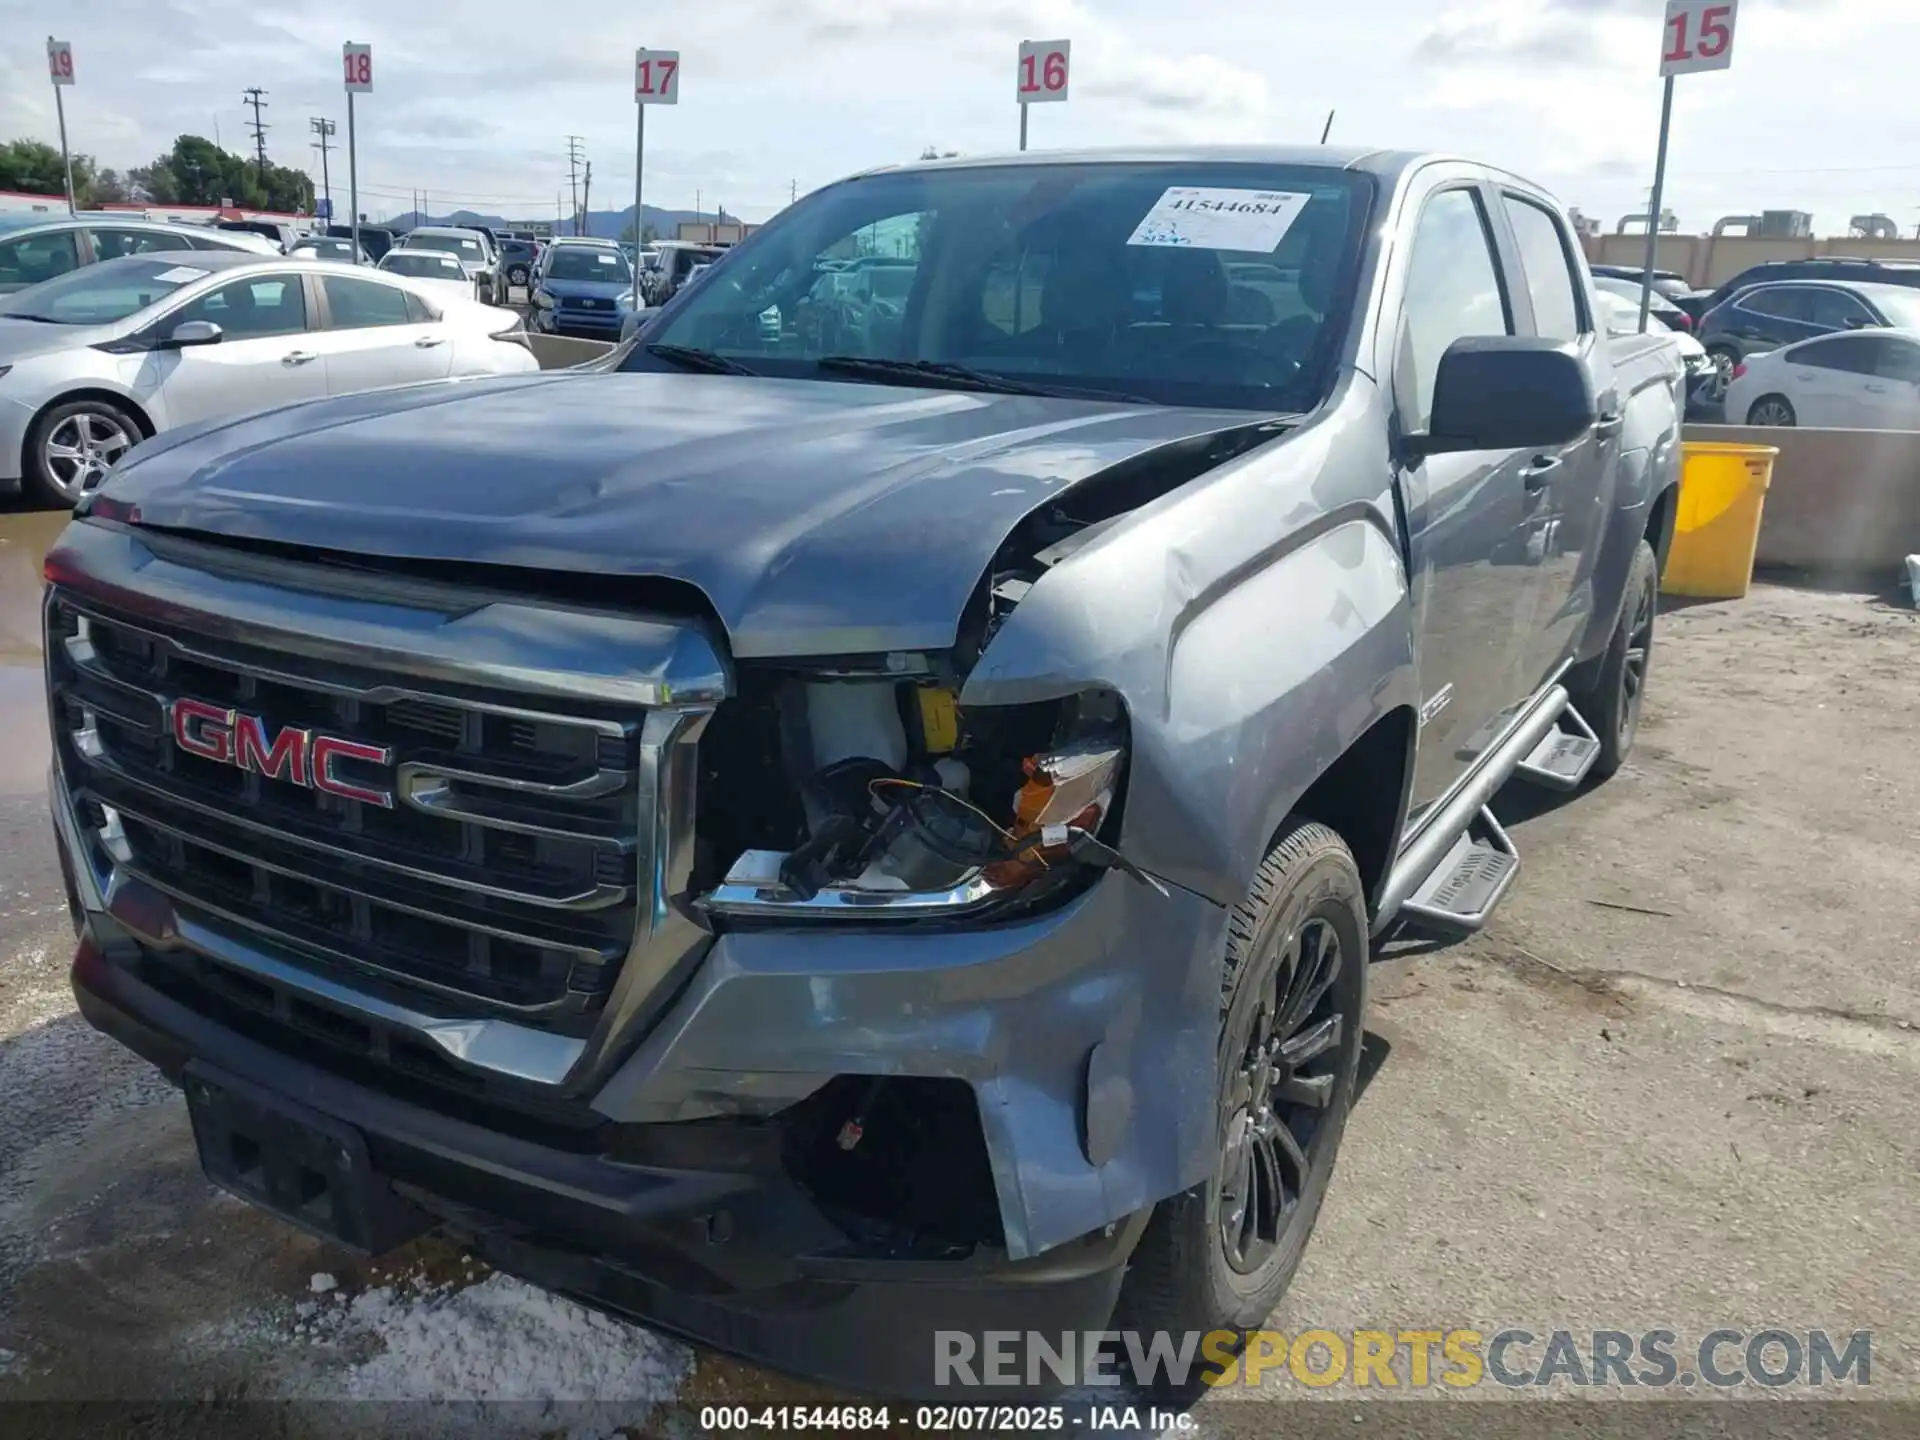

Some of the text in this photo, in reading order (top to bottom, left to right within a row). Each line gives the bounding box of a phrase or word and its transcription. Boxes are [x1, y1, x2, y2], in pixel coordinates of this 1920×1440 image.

[1664, 6, 1730, 62] 15
[50, 50, 73, 77] 19
[343, 53, 371, 84] 18
[636, 60, 677, 94] 17
[1019, 52, 1066, 92] 16
[1168, 199, 1282, 215] 41544684
[171, 697, 393, 809] GMC
